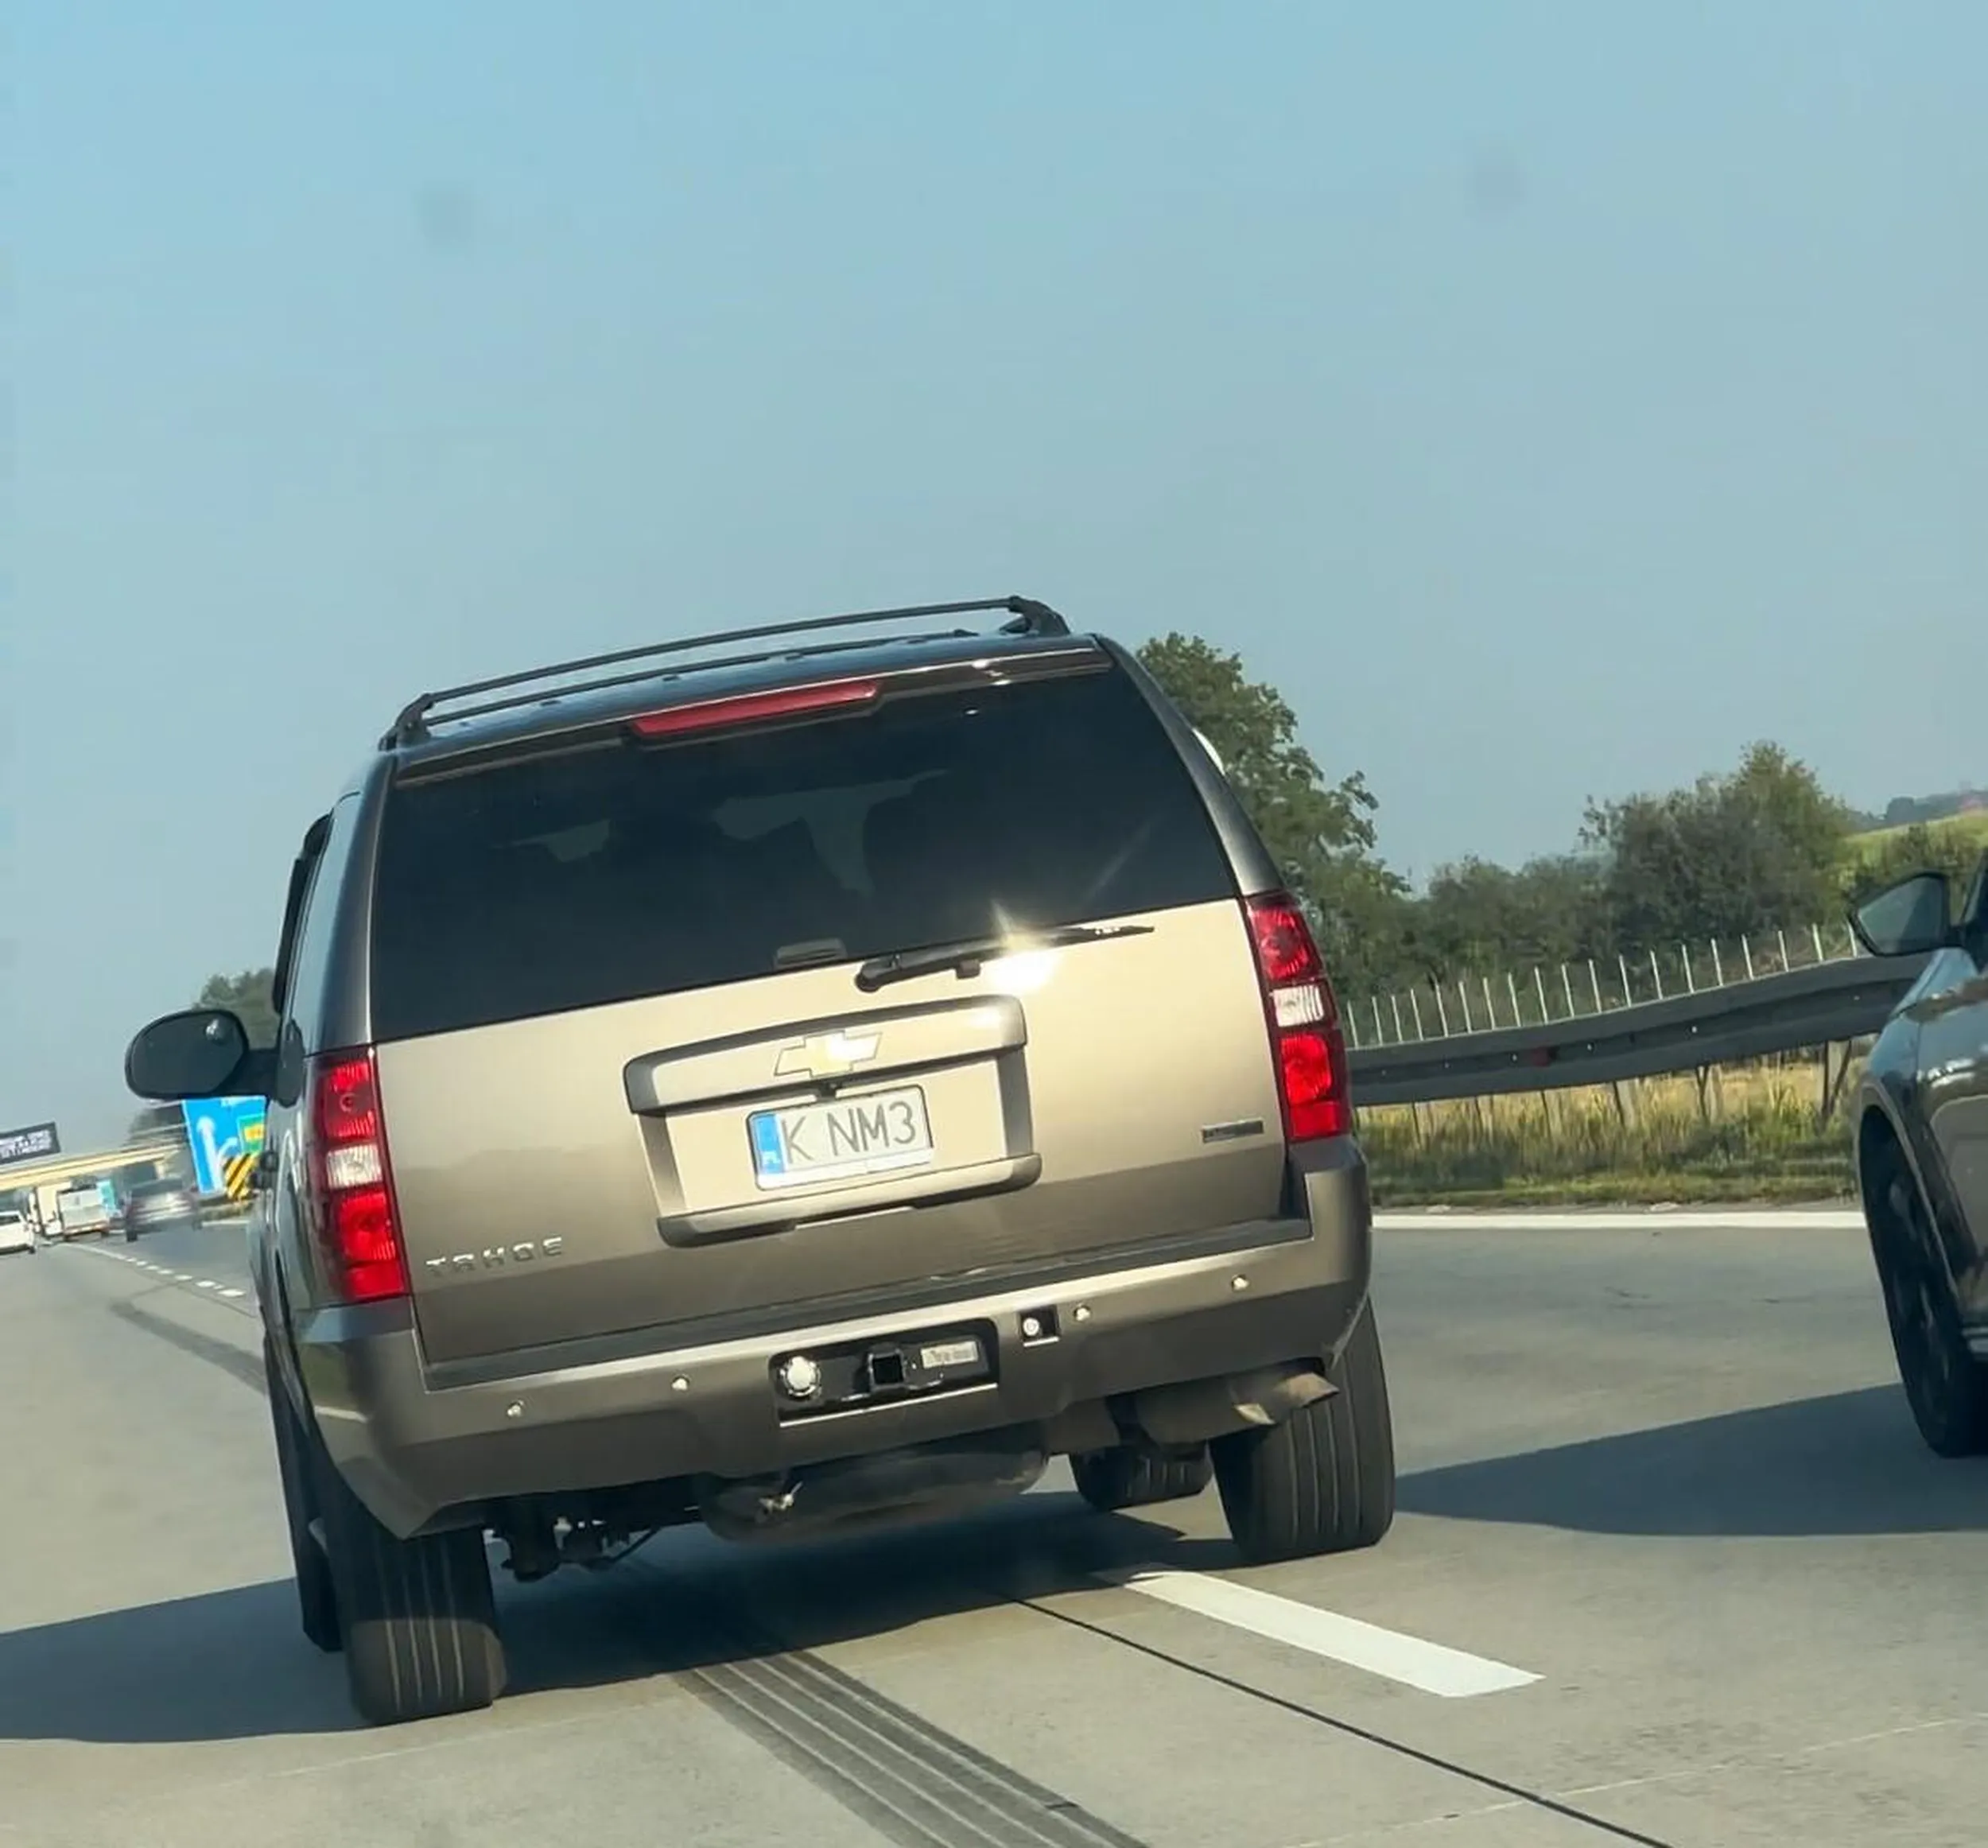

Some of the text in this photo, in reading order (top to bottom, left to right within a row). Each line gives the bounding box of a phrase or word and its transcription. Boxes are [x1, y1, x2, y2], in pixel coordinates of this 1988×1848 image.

[781, 1101, 916, 1164] K NM3
[425, 1236, 563, 1276] TAHOE
